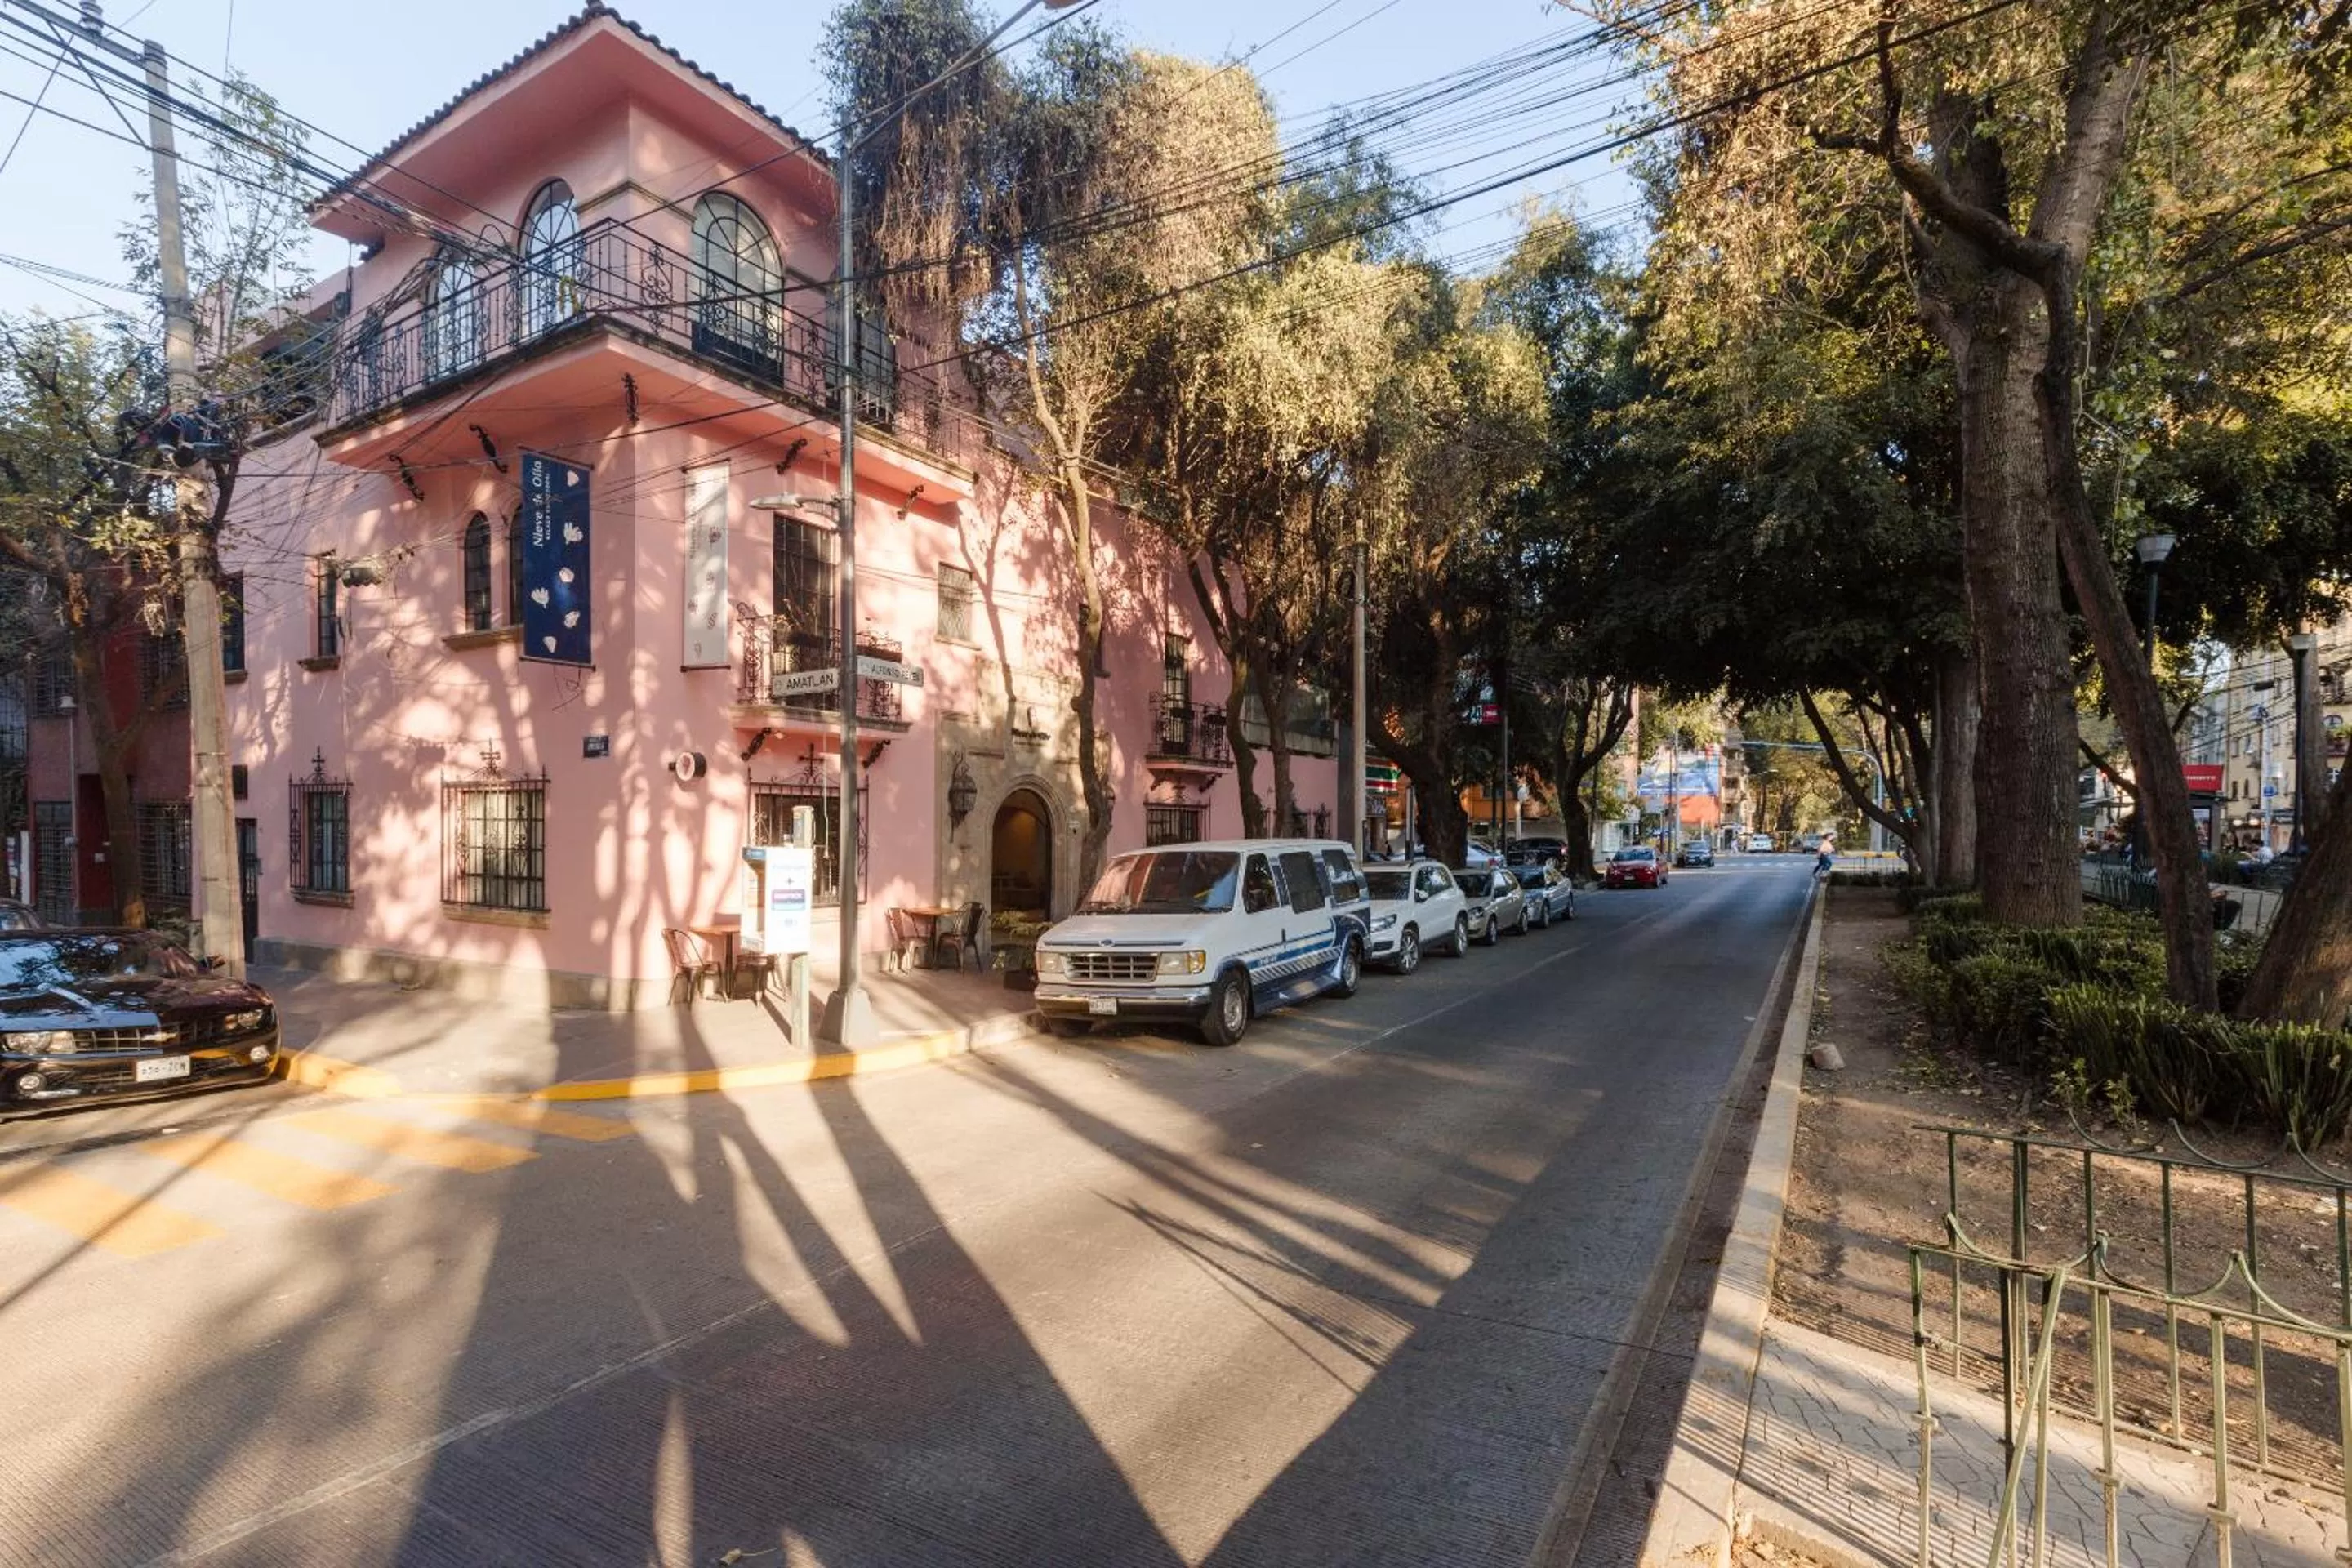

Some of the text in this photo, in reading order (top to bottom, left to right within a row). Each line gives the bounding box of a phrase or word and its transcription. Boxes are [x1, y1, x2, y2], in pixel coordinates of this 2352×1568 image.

[532, 461, 542, 487] Olla
[532, 510, 543, 548] Nieve
[786, 674, 834, 690] AMATLAN
